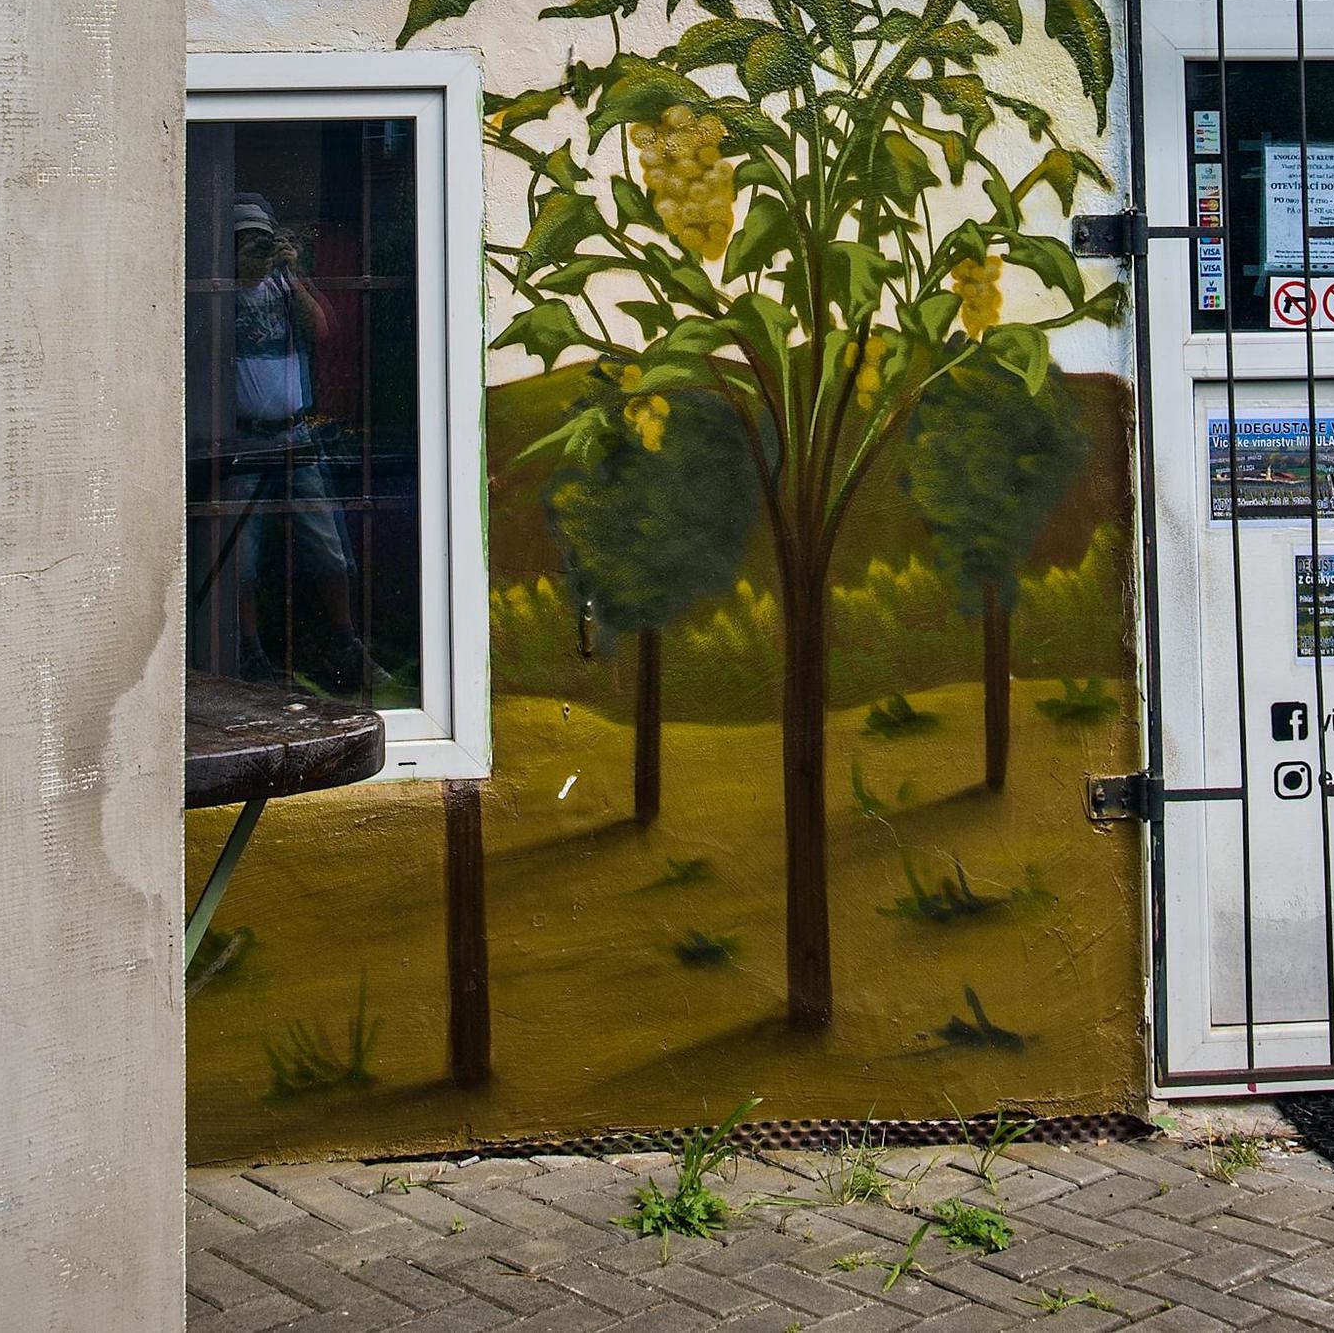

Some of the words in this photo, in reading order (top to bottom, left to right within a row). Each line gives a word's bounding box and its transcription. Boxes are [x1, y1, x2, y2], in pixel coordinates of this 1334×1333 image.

[1203, 248, 1221, 256] VISA
[1203, 264, 1221, 272] VISA
[1298, 575, 1304, 584] z
